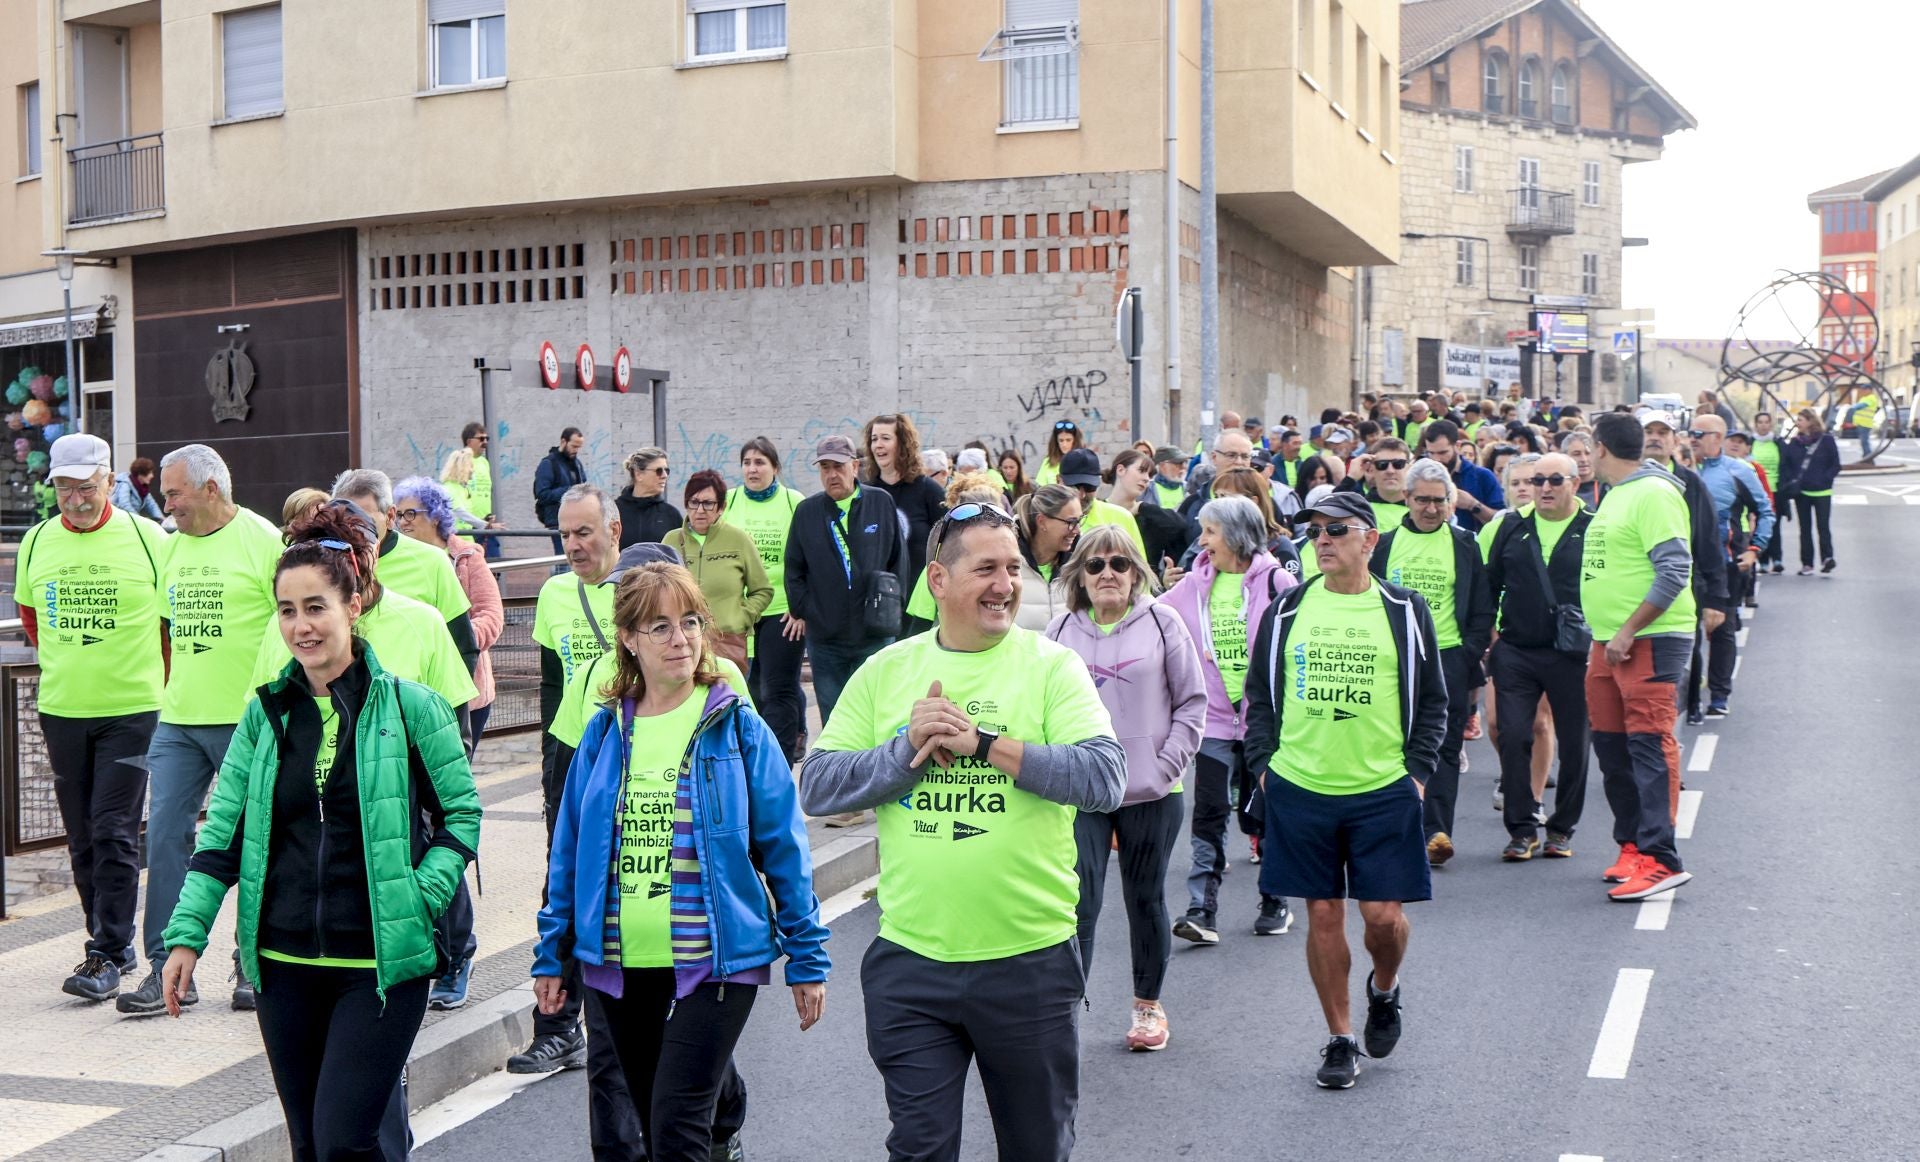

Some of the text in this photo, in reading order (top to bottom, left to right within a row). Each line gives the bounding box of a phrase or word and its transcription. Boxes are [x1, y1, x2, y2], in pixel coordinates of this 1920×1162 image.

[59, 585, 118, 596] el cáncer
[176, 588, 224, 599] el cáncer
[46, 581, 57, 629] ARABA
[59, 596, 118, 607] martxan
[176, 598, 223, 611] martxan
[59, 607, 117, 615] minbiziaren
[176, 611, 223, 621] minbiziaren
[59, 615, 116, 629] aurka
[176, 620, 223, 638] aurka
[572, 640, 583, 650] el
[1320, 642, 1350, 650] marcha
[573, 650, 604, 661] mart
[1215, 645, 1249, 660] aurk
[1308, 648, 1377, 662] el cáncer
[1294, 642, 1307, 701] ARABA
[1308, 661, 1375, 676] martxan
[1308, 672, 1374, 686] minbiziaren
[1307, 685, 1372, 705] aurka
[633, 790, 669, 799] marcha
[916, 787, 1006, 813] aurka
[623, 799, 674, 815] el cán
[622, 816, 674, 832] martx
[913, 820, 939, 833] Vital
